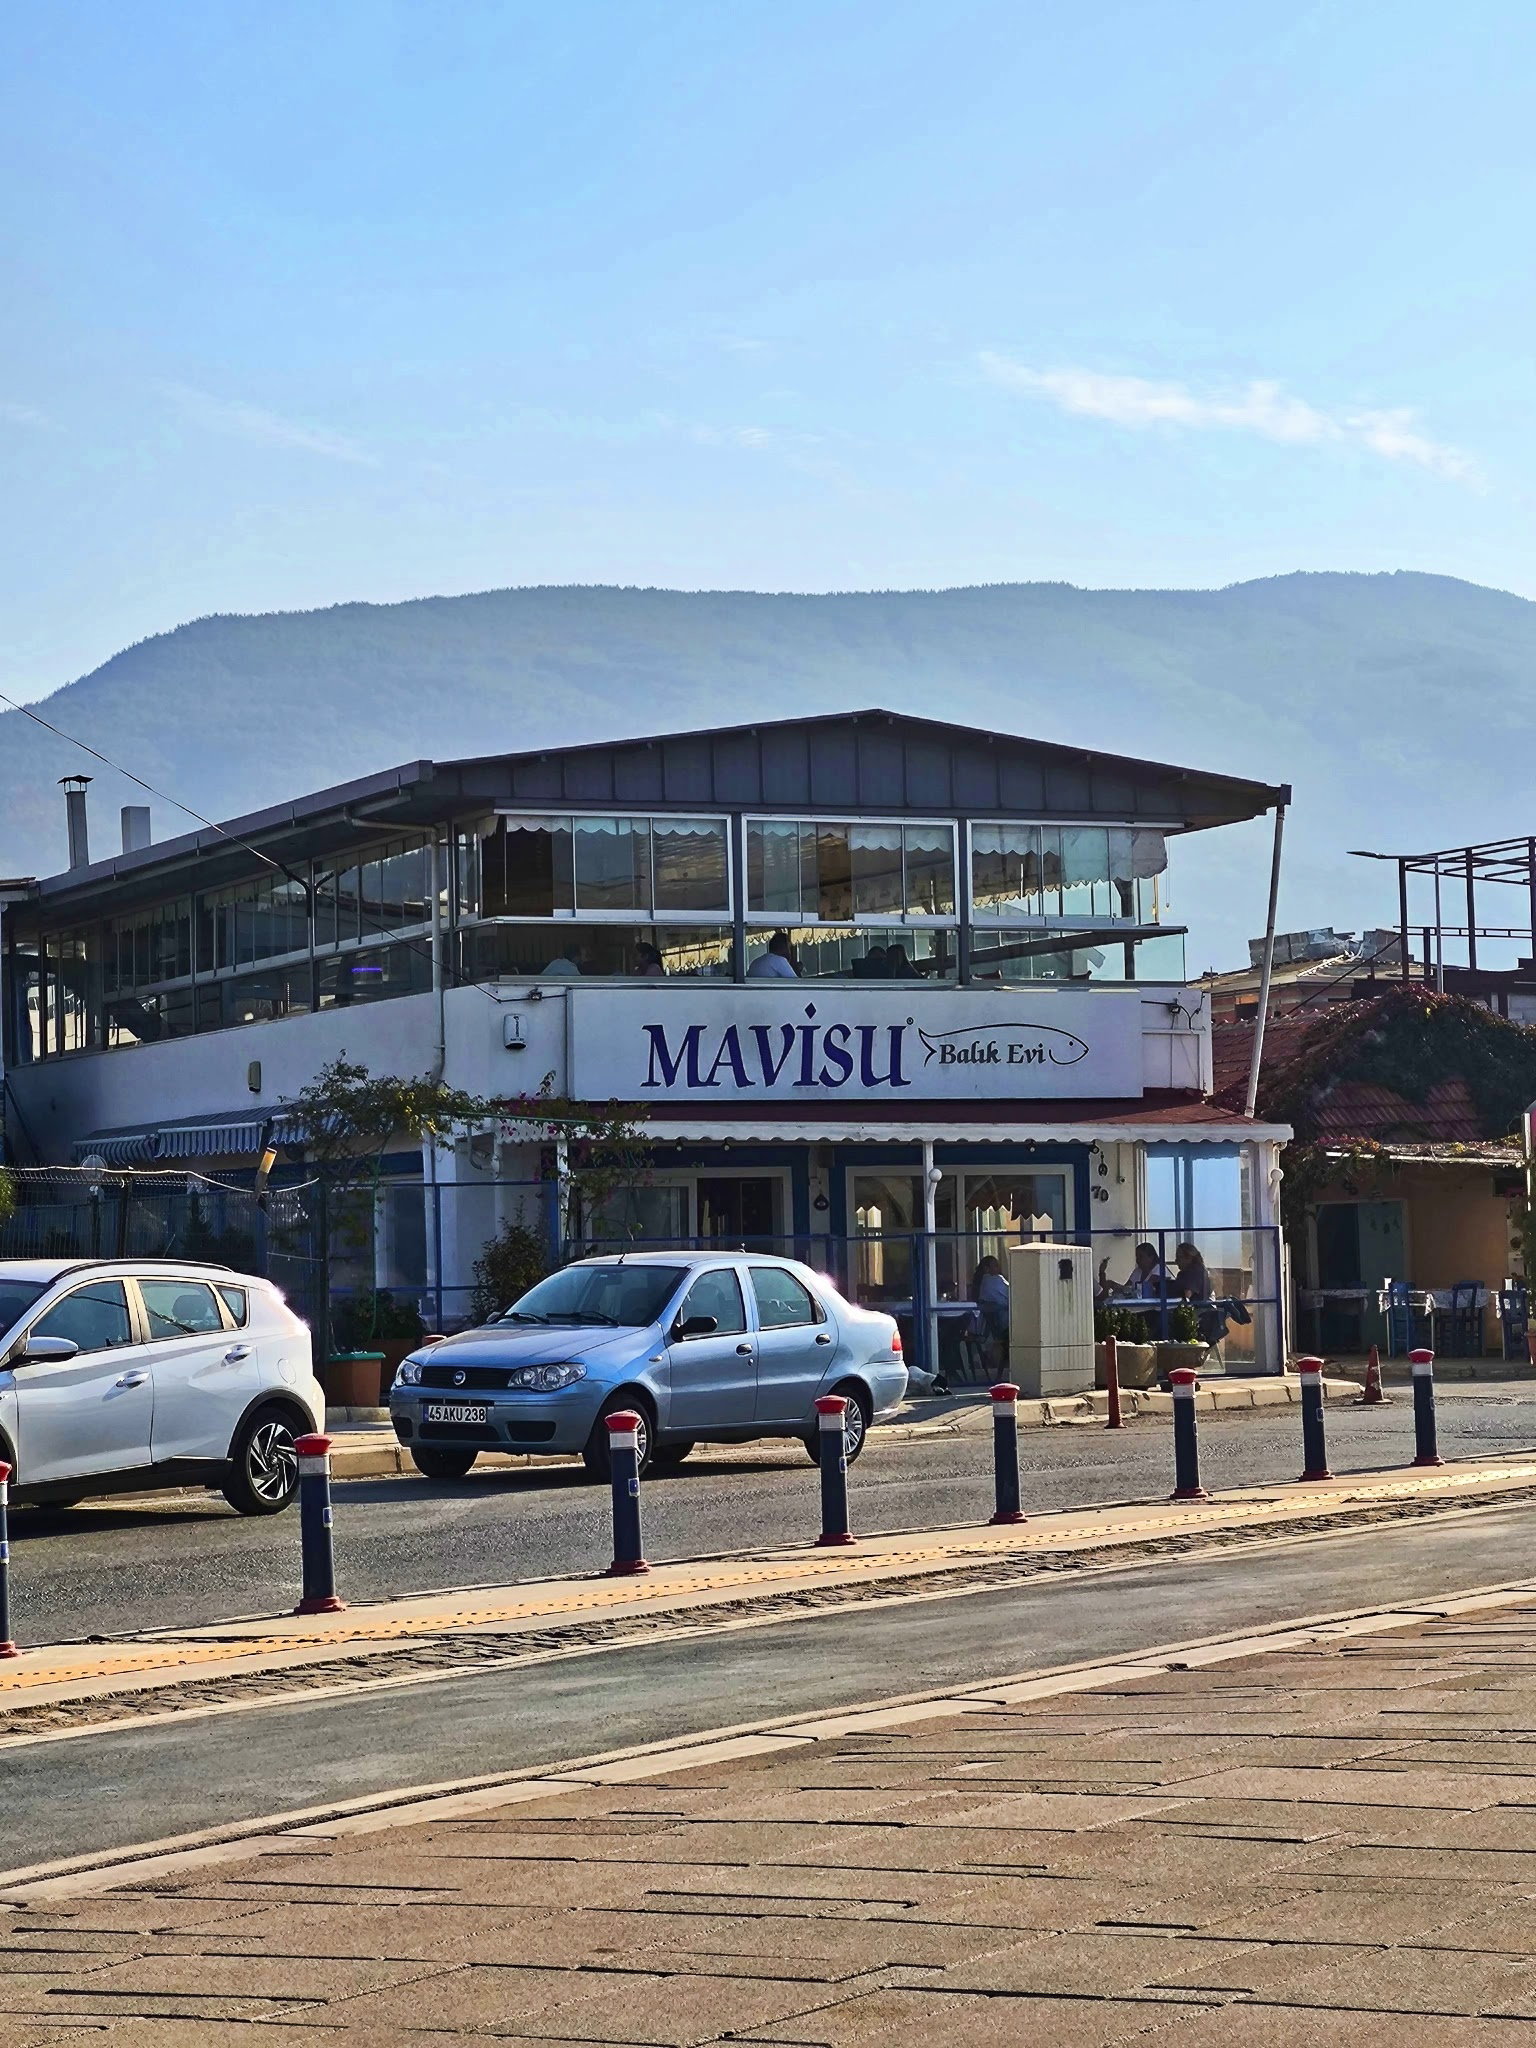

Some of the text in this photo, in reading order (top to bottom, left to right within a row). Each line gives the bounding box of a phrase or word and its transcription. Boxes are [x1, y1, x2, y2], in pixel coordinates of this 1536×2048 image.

[939, 1041, 1046, 1065] Balık Evi
[1091, 1186, 1109, 1202] 70
[429, 1407, 485, 1421] 45 AKU 238
